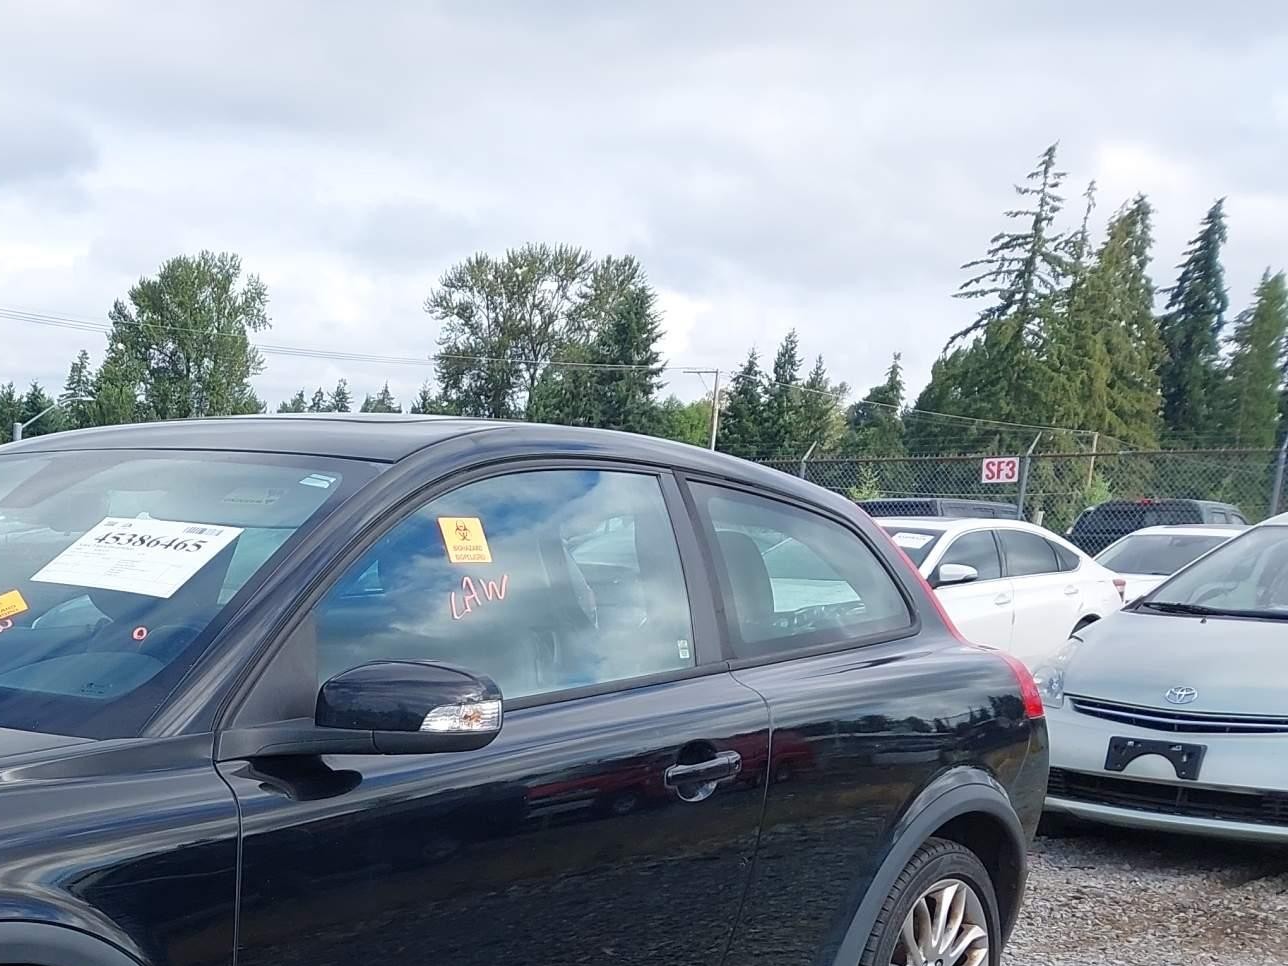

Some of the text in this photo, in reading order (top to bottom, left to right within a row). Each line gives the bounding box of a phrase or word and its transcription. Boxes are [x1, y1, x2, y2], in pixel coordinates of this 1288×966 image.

[985, 460, 1016, 480] SF3
[94, 532, 208, 552] 45386465
[451, 574, 508, 620] LAW
